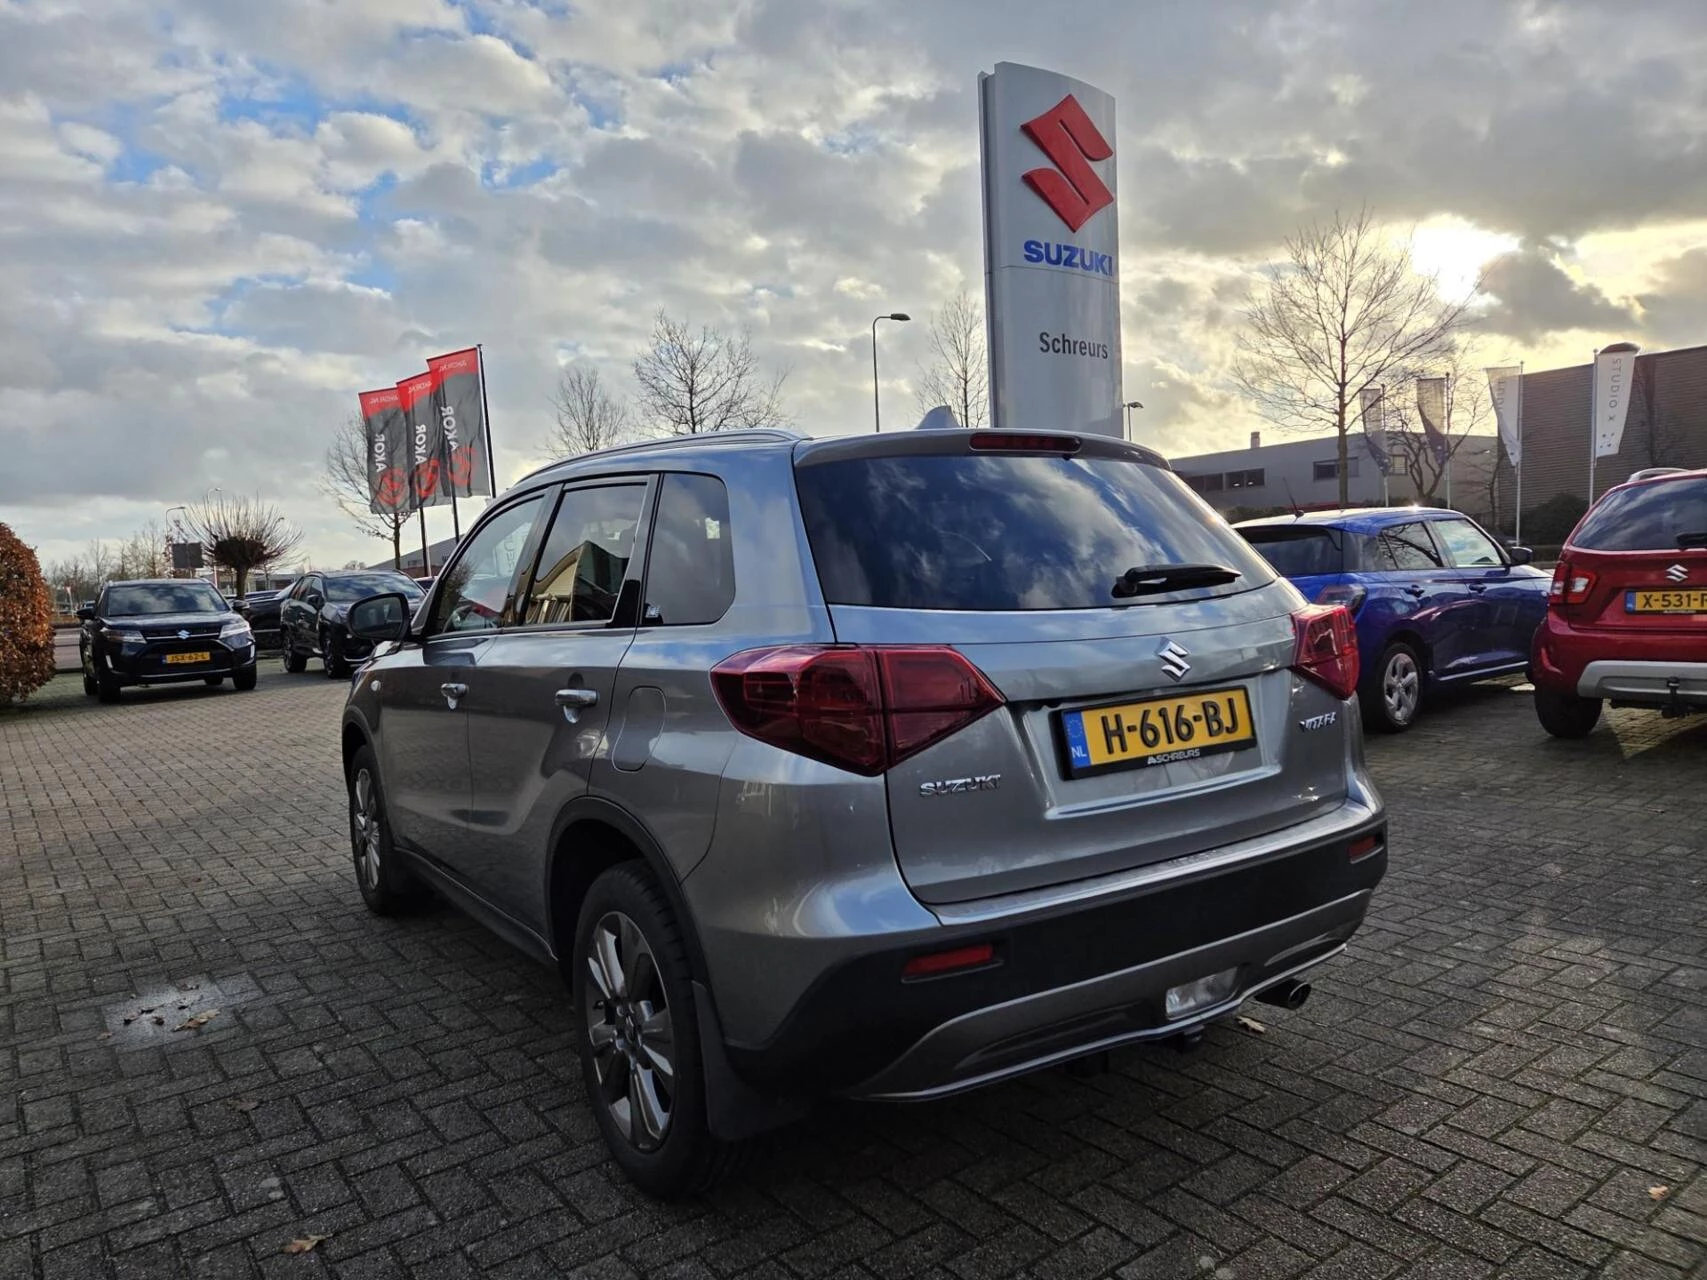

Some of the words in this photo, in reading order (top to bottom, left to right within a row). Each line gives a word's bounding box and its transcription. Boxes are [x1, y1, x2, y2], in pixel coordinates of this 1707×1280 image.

[1023, 239, 1113, 277] SUZUKI
[1039, 331, 1108, 359] Schreurs
[1608, 358, 1622, 408] STUDIO
[1101, 697, 1239, 754] H-616-BJ
[1071, 746, 1087, 758] NL
[920, 774, 1001, 797] SUZUKI
